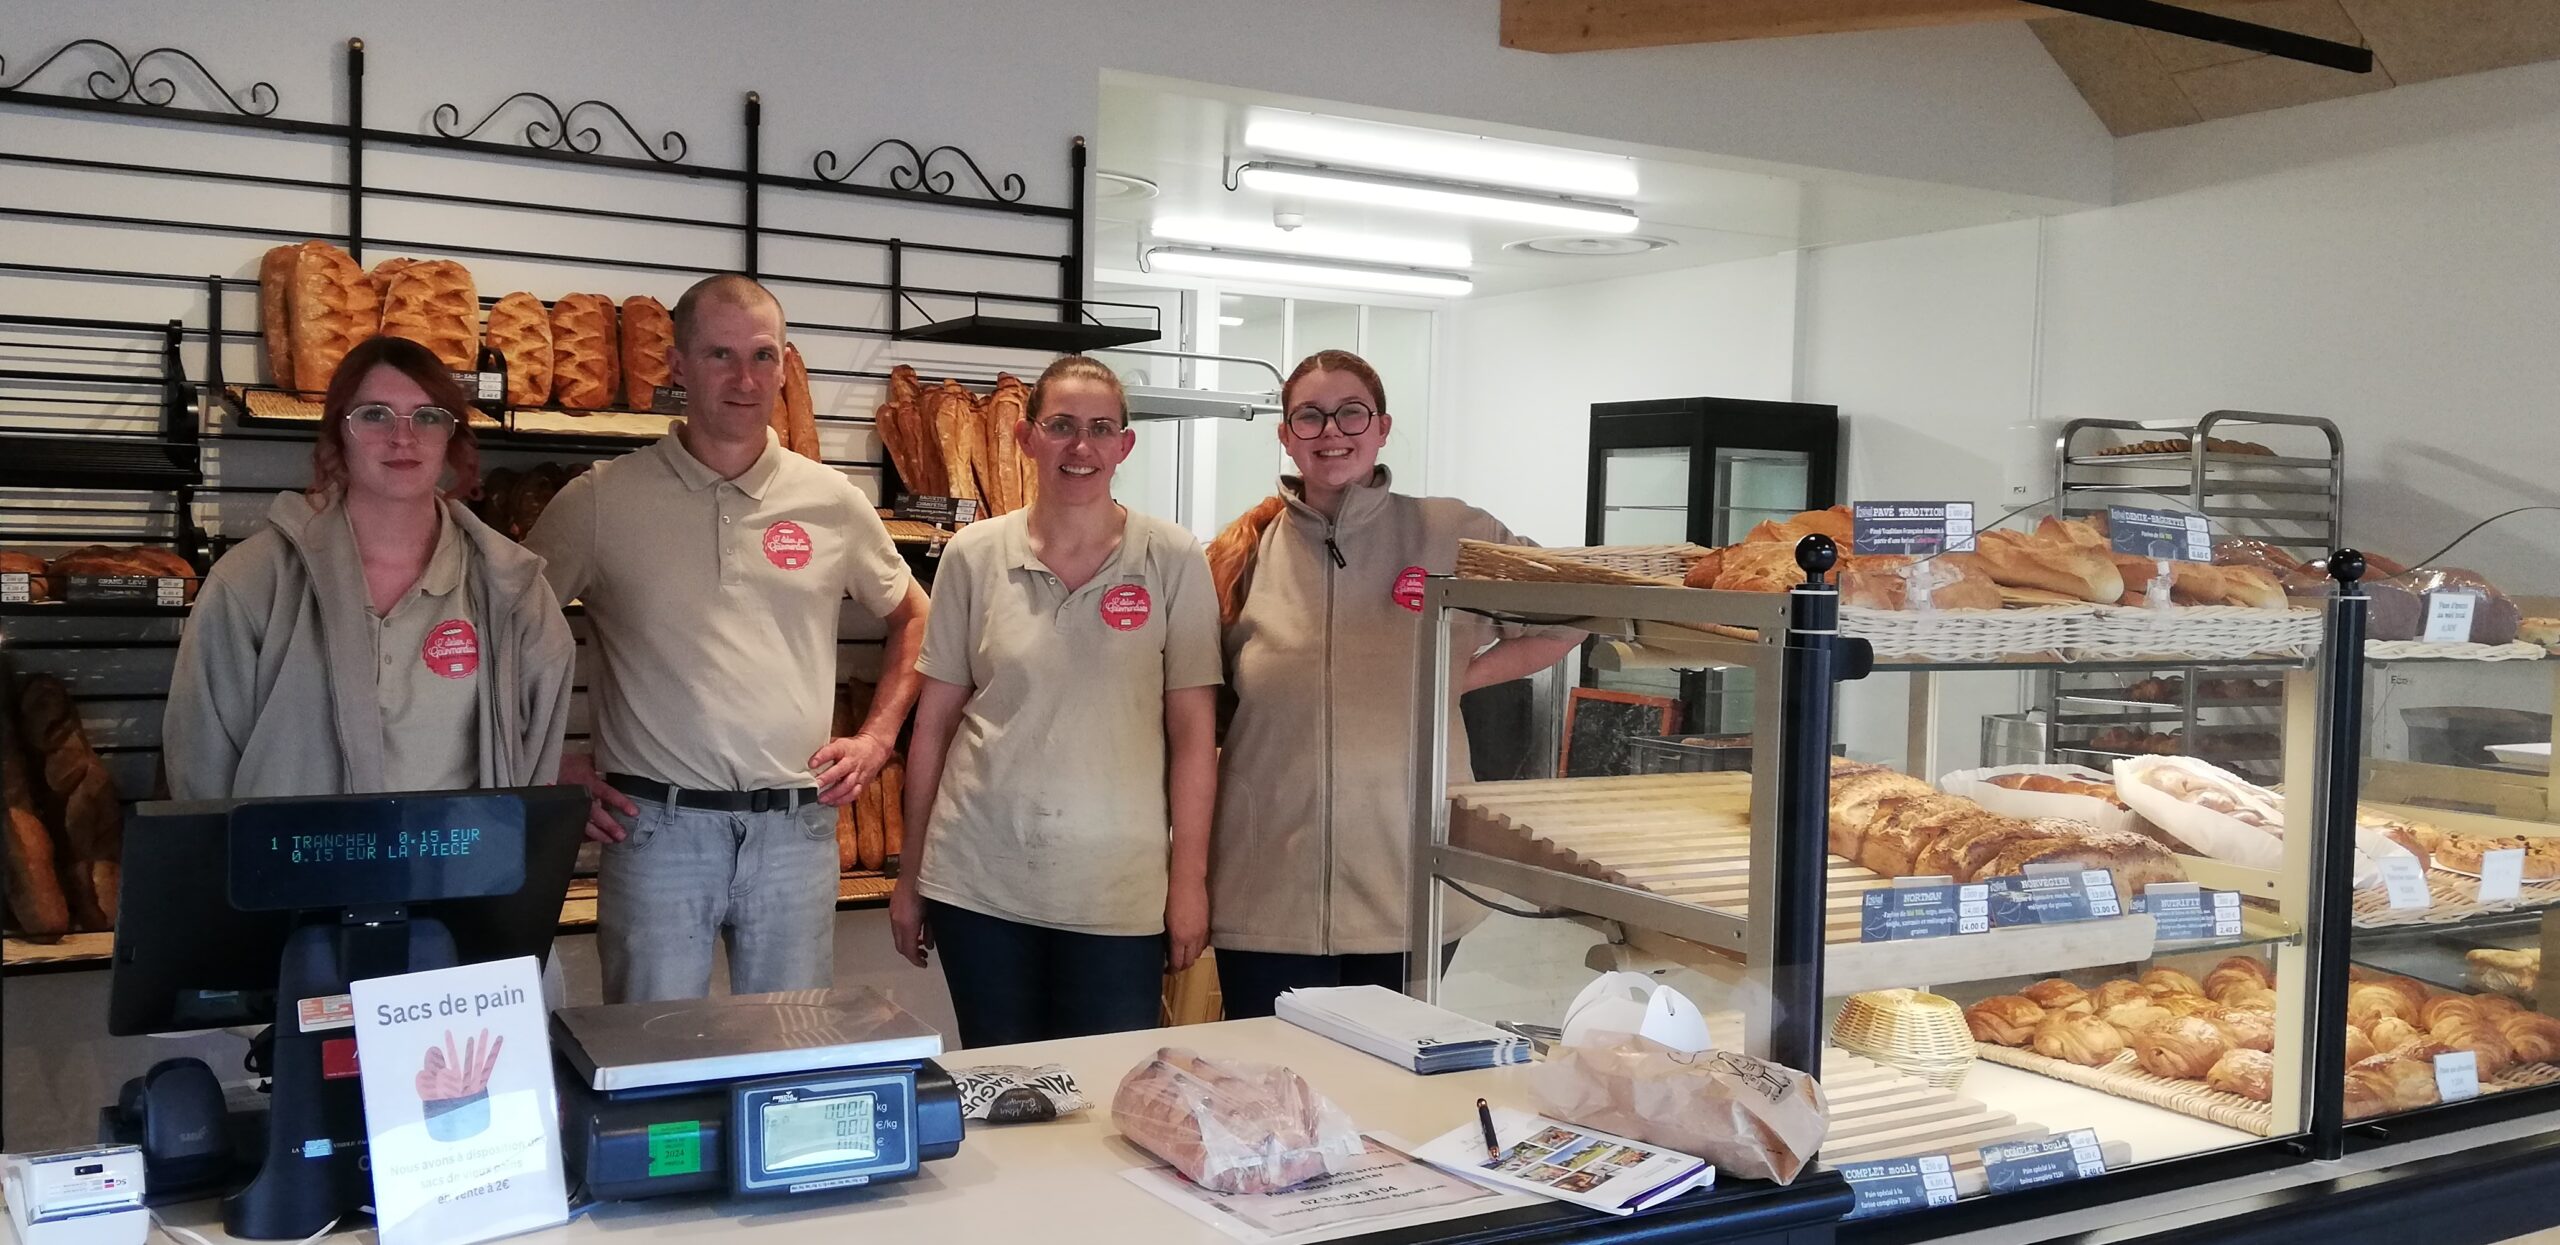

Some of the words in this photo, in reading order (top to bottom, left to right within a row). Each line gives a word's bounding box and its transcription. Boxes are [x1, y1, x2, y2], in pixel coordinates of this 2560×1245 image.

[1873, 504, 1895, 517] PAVÉ
[1898, 507, 1945, 517] TRADITION
[271, 837, 278, 850] 1
[292, 833, 377, 849] TRANCHEU
[399, 831, 439, 844] 0.15
[450, 828, 480, 842] EUR
[292, 849, 333, 863] 0.15
[346, 847, 376, 861] EUR
[388, 844, 408, 858] LA
[419, 842, 470, 857] PIECE
[377, 1002, 432, 1026] Sacs
[438, 993, 467, 1016] de
[474, 985, 525, 1017] pain
[1023, 1074, 1082, 1096] PAIN
[876, 1102, 888, 1112] kg
[961, 1076, 1014, 1117] BAGUE
[875, 1118, 898, 1130] €/kg
[876, 1138, 885, 1146] €
[421, 1155, 455, 1170] avons
[465, 1140, 526, 1162] disposition
[1845, 1166, 1884, 1179] COMPLET
[1888, 1163, 1917, 1175] moule
[495, 1178, 511, 1191] 2€
[1265, 1187, 1295, 1198] Pour
[1328, 1172, 1385, 1186] contacter
